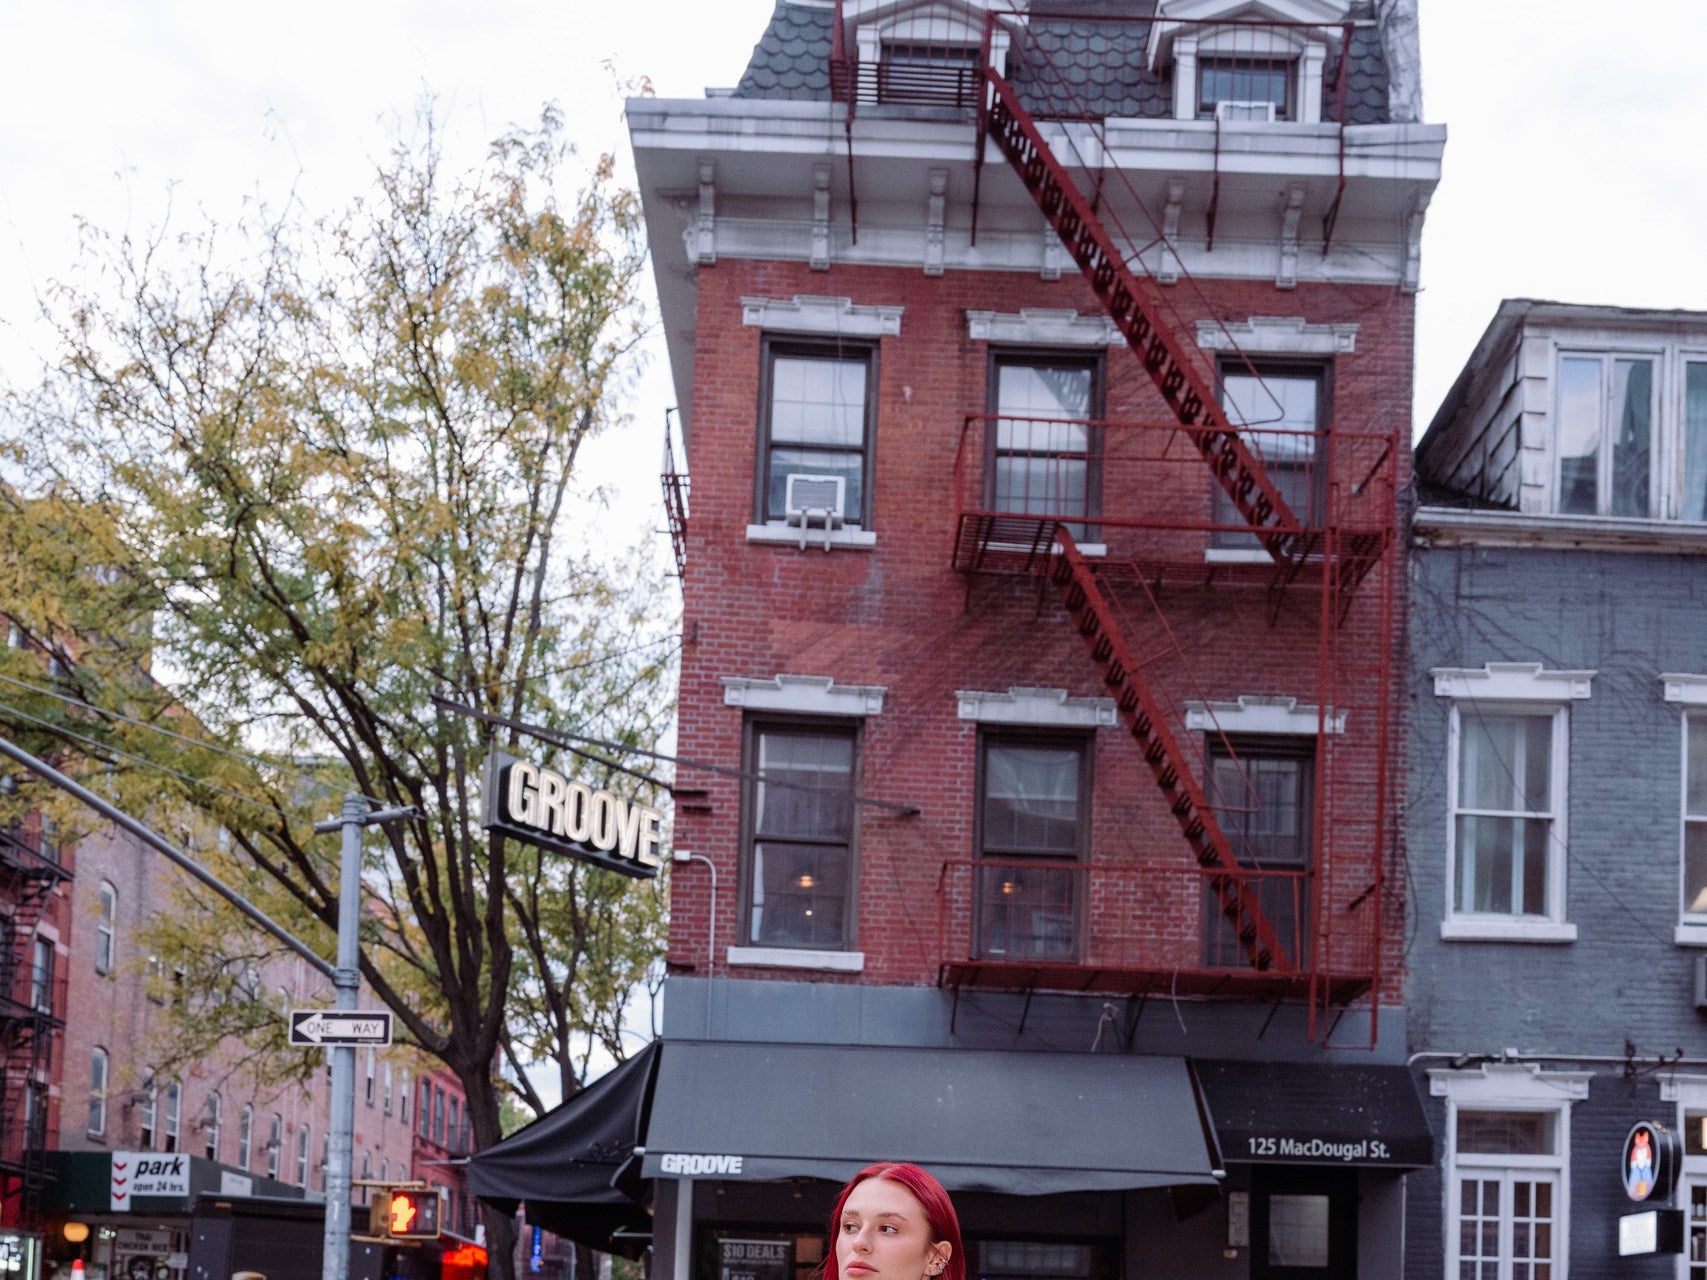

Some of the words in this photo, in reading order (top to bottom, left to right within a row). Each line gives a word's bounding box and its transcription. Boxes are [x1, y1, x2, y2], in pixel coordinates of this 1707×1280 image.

[508, 760, 661, 867] GROOVE
[307, 1022, 333, 1035] ONE
[352, 1023, 380, 1035] WAY
[1249, 1137, 1276, 1155] 125
[1279, 1138, 1367, 1161] MacDougal
[1369, 1140, 1391, 1159] St.
[135, 1157, 184, 1179] park
[660, 1153, 743, 1175] GROOVE
[132, 1184, 154, 1192] open
[156, 1181, 167, 1192] 24
[169, 1182, 186, 1192] hrs.
[746, 1245, 786, 1260] DEALS
